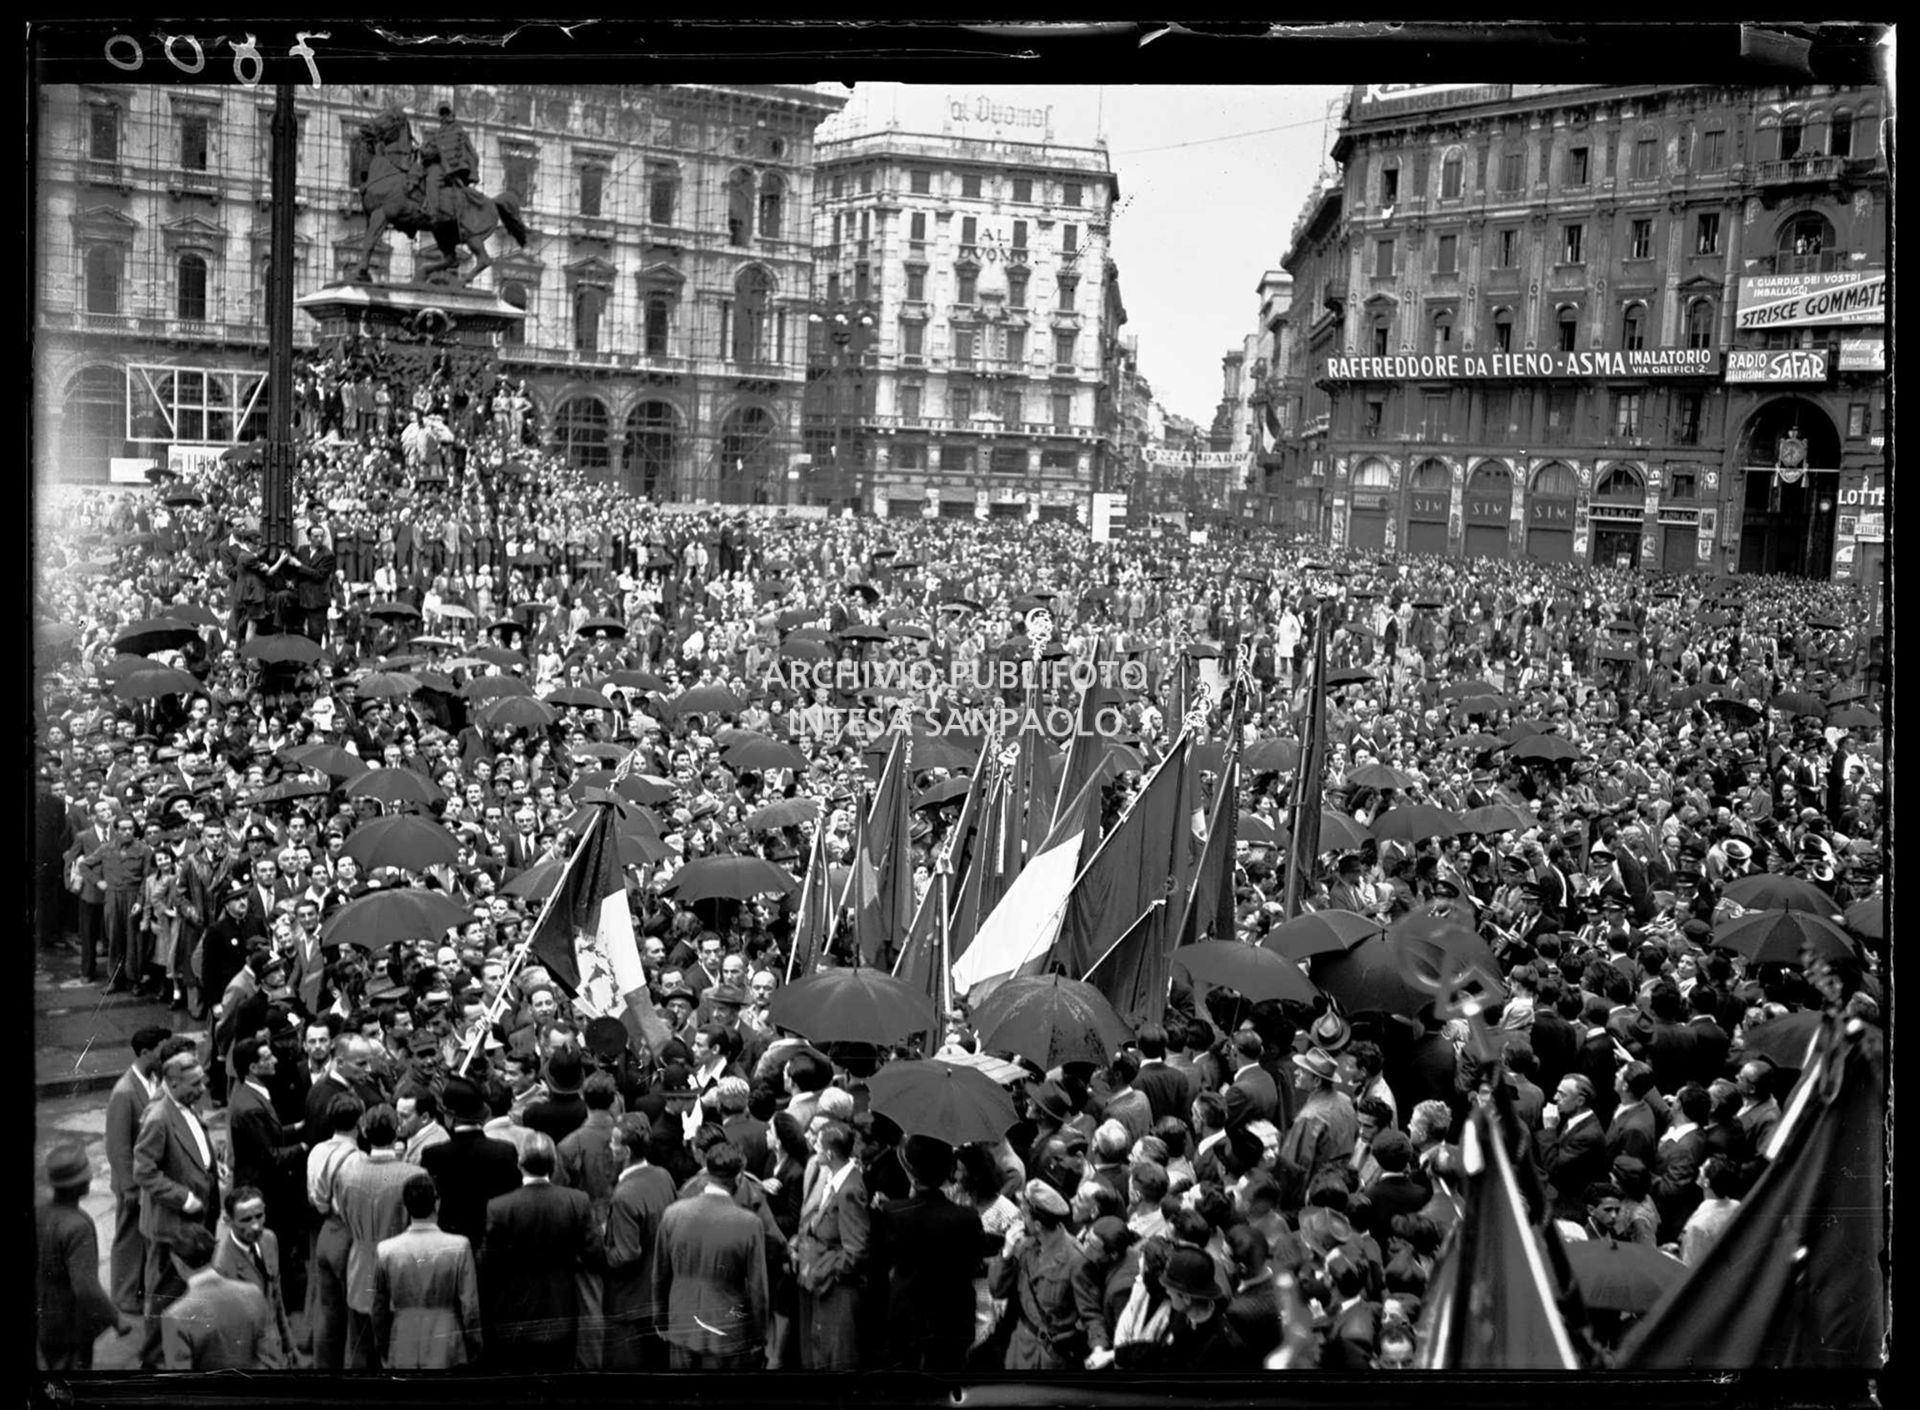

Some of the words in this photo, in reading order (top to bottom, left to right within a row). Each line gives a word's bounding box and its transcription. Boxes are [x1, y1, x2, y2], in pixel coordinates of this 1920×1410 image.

[979, 228, 1010, 241] AL
[1746, 279, 1754, 288] A
[1757, 276, 1801, 287] GUARDIA
[1804, 275, 1820, 285] DEI
[1824, 273, 1861, 284] VOSTRI
[1753, 285, 1808, 298] IMBALLAGGI
[1741, 301, 1800, 327] STRISCE
[1805, 282, 1885, 316] GOMMATE
[1328, 355, 1459, 378] RAFFREDDORE
[1464, 357, 1488, 377] DA
[1492, 353, 1553, 376] FIENO
[1566, 352, 1626, 375] ASMA
[1629, 350, 1711, 365] INALATORIO
[1728, 353, 1767, 369] RADIO
[1632, 366, 1649, 375] VIA
[1652, 364, 1694, 374] OREFICI
[1769, 352, 1825, 379] SAFAR
[1415, 500, 1443, 513] SIM
[1472, 502, 1503, 516] SIM
[1535, 505, 1567, 520] SIM
